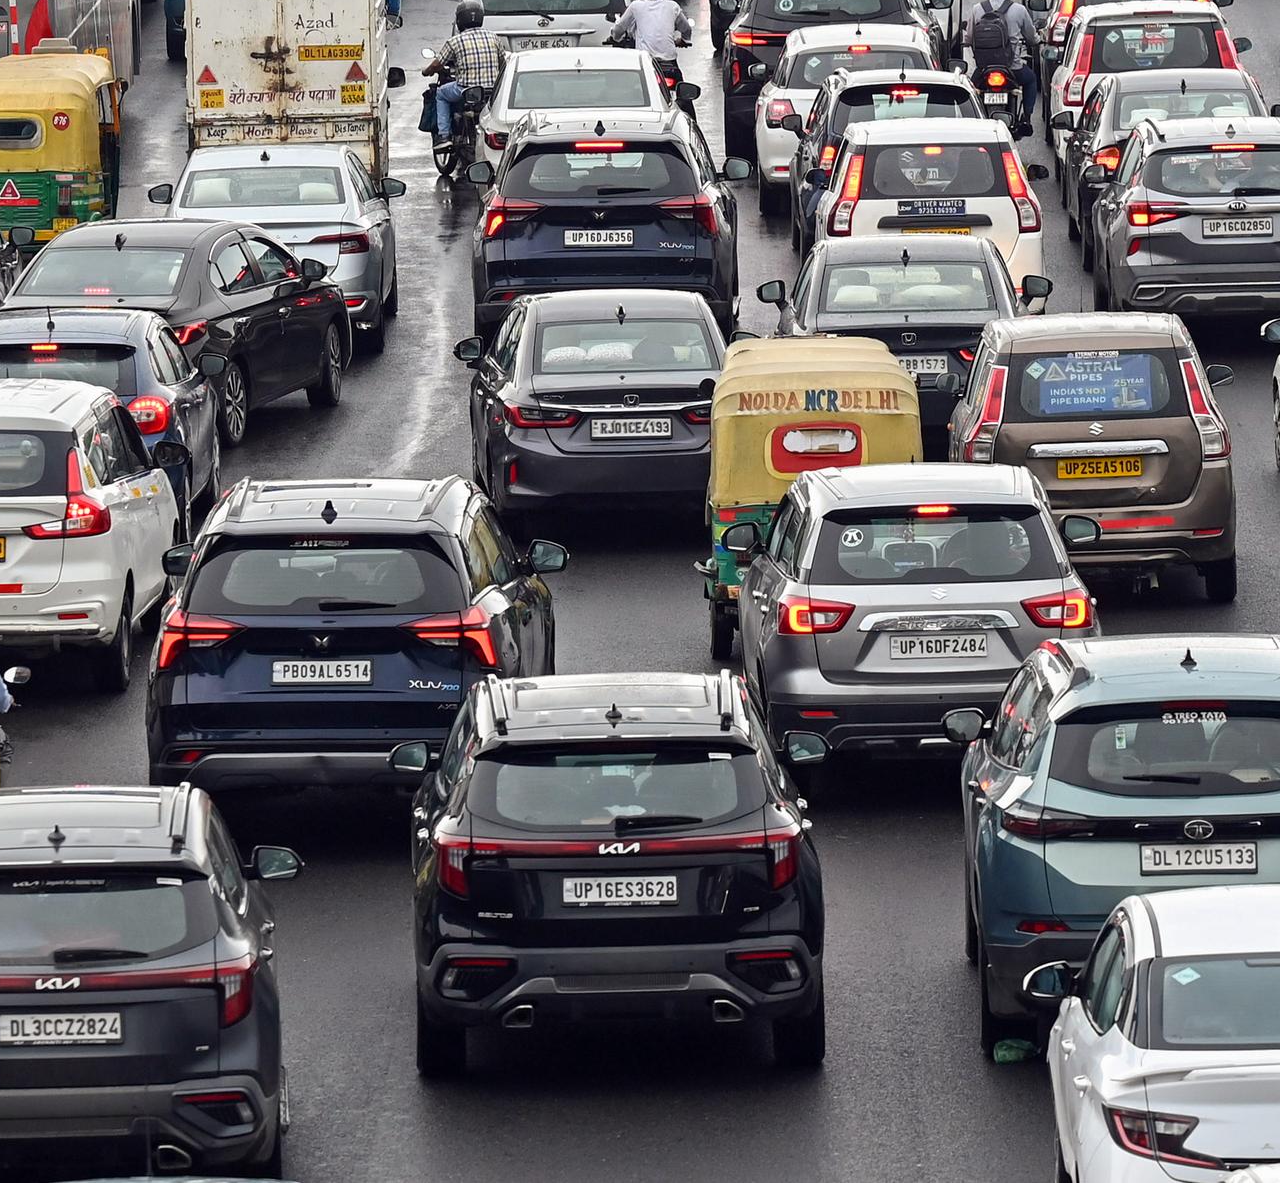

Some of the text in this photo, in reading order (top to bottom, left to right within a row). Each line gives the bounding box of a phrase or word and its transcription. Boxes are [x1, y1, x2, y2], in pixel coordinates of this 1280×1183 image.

[293, 12, 335, 30] Azad
[551, 39, 570, 48] 4634
[305, 47, 361, 59] DL1LAG3304
[245, 126, 274, 138] Horn
[334, 122, 367, 134] Distance
[1231, 202, 1248, 212] KIA
[572, 230, 632, 243] UP16DJ6356
[1065, 360, 1122, 374] ASTRAL
[1070, 372, 1103, 382] PIPES
[1050, 387, 1107, 398] INDIA'S NO.1
[739, 389, 901, 413] NOIDA NCR DELHI
[1050, 396, 1107, 407] PIPE BRAND
[600, 421, 670, 435] RJ01CE4193
[1065, 459, 1141, 476] UP25EA5106
[900, 638, 986, 656] UP16DF2484
[282, 664, 370, 680] PB09AL6514
[409, 680, 460, 691] XUV700
[1200, 711, 1227, 720] TATA
[598, 842, 640, 855] KIA
[1153, 849, 1254, 868] DL12CU5133
[573, 881, 675, 900] UP16ES3628
[35, 977, 81, 991] KIA
[10, 1018, 119, 1037] DL3CCZ2824
